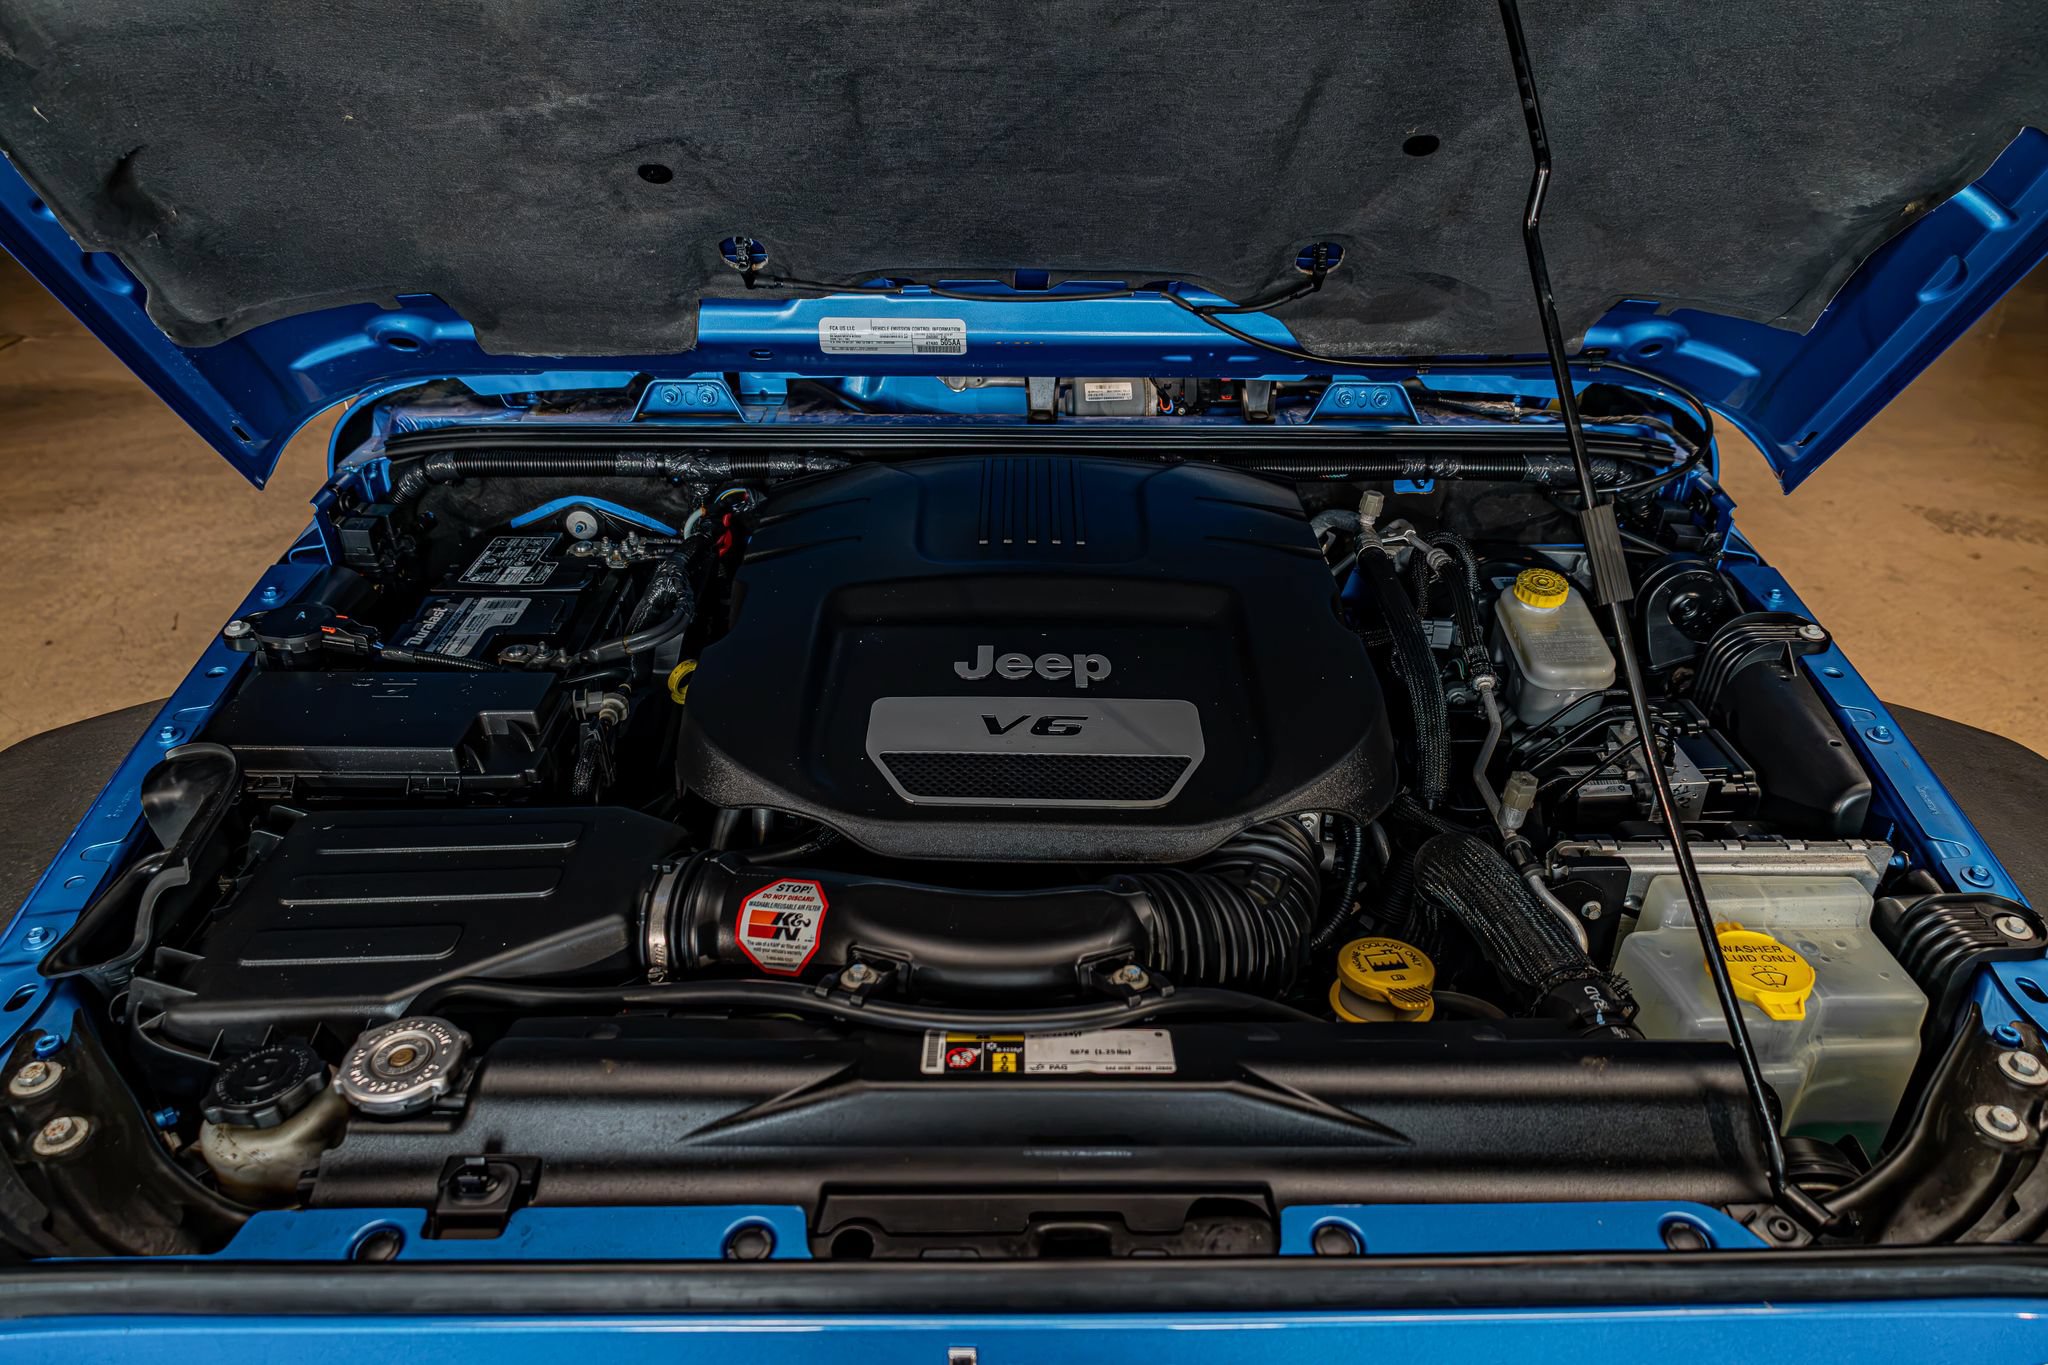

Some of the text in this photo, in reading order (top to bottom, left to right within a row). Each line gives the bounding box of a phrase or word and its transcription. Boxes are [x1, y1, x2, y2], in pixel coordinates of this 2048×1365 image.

[940, 338, 961, 346] 505AA
[403, 607, 450, 647] Duralast
[953, 645, 1112, 688] Jeep
[980, 713, 1089, 736] V6
[776, 884, 813, 894] STOP!
[1357, 942, 1402, 951] COOLANT
[1404, 950, 1424, 967] ONLY
[1720, 945, 1783, 953] WASHER
[1724, 955, 1797, 963] LUID ONLY
